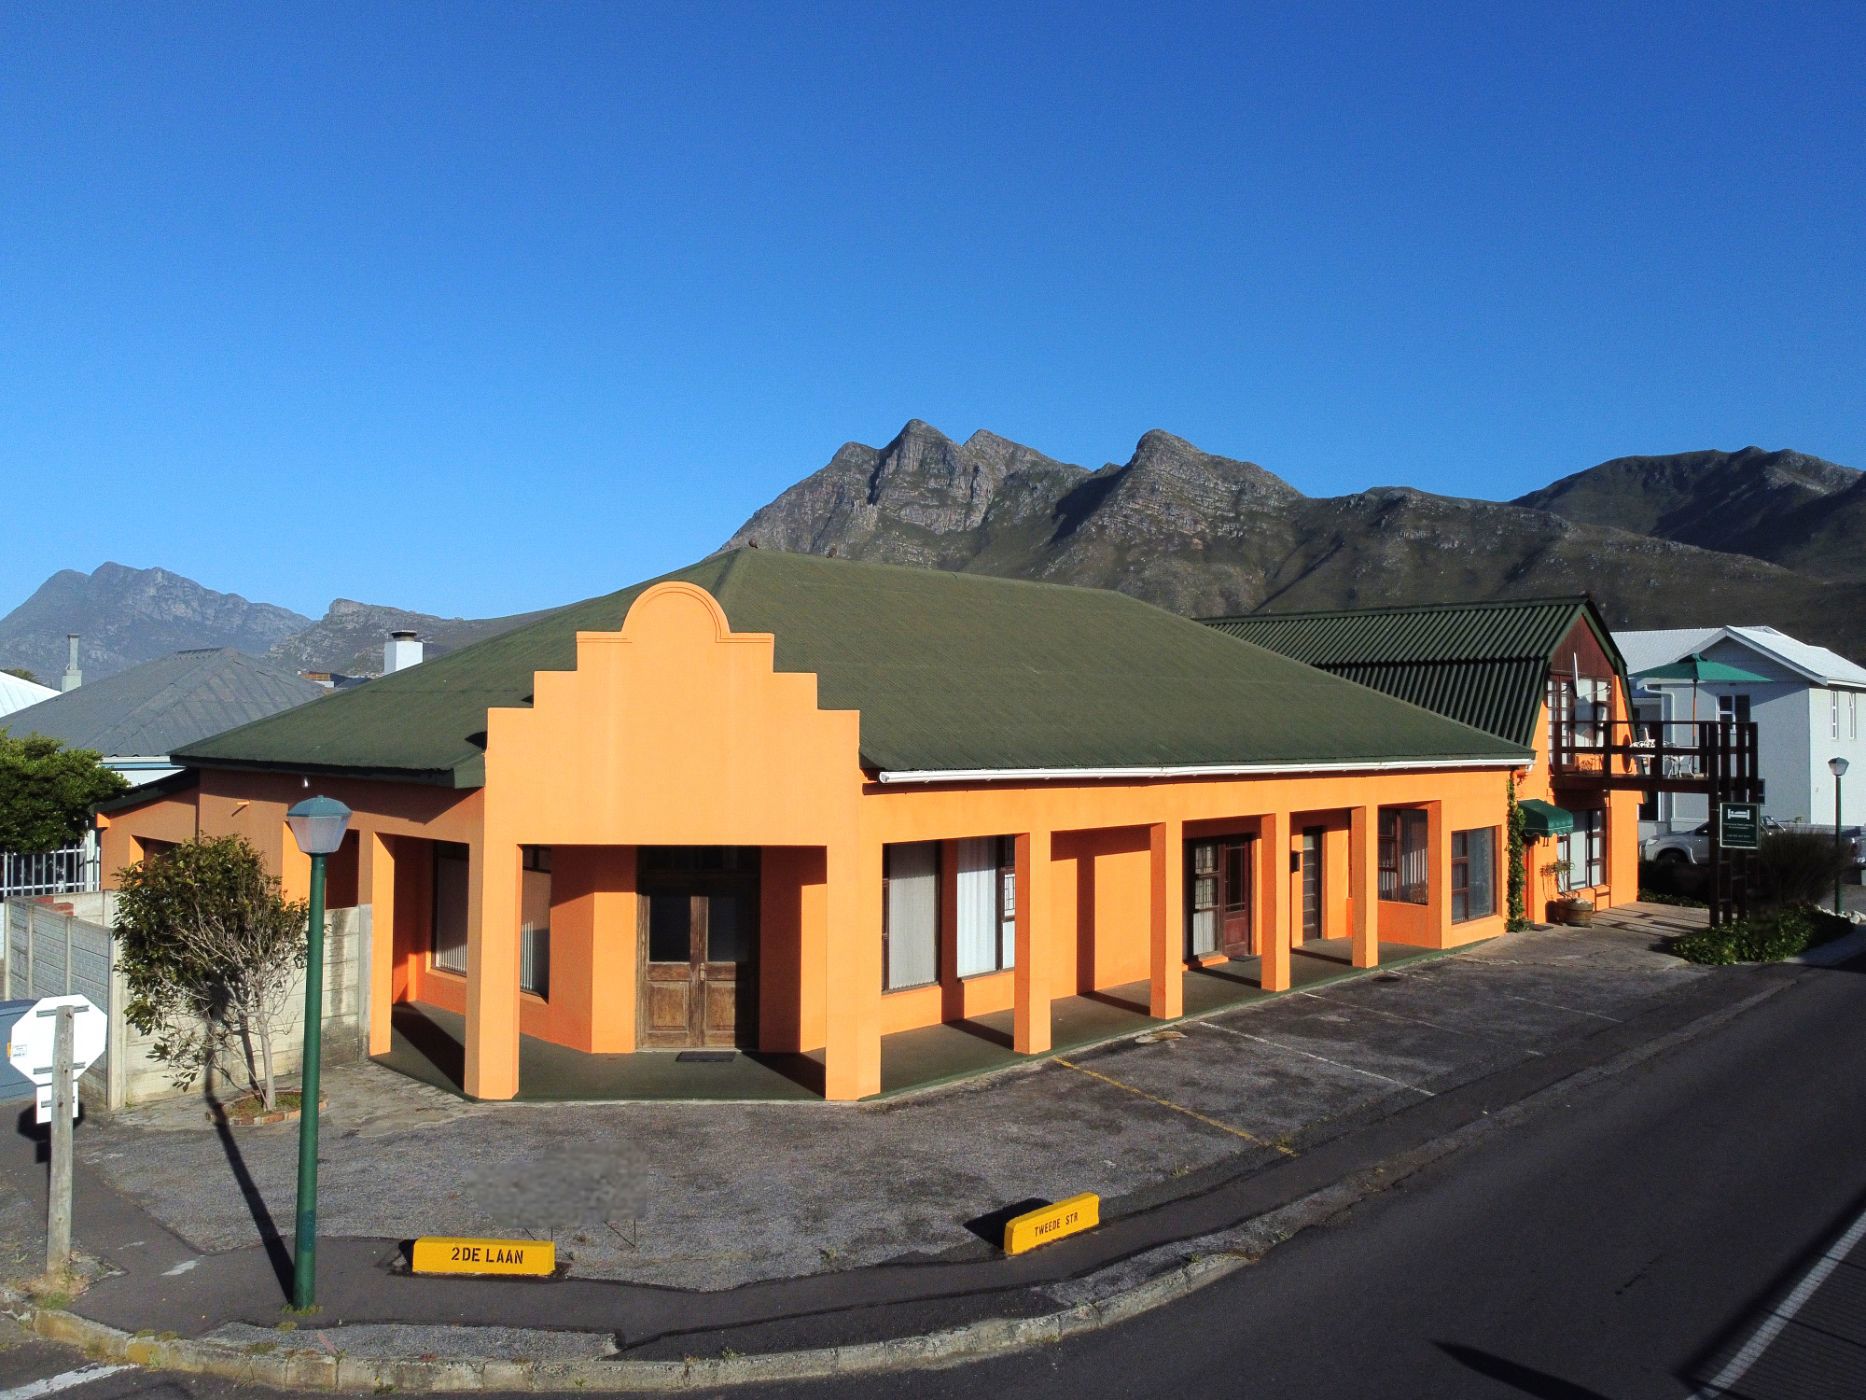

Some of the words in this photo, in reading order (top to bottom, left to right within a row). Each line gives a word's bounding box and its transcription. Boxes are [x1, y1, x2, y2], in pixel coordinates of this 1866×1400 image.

[1034, 1218, 1060, 1238] TWEEDE
[1065, 1211, 1079, 1225] STR
[451, 1246, 481, 1262] 2DE
[485, 1248, 524, 1264] LAAN
